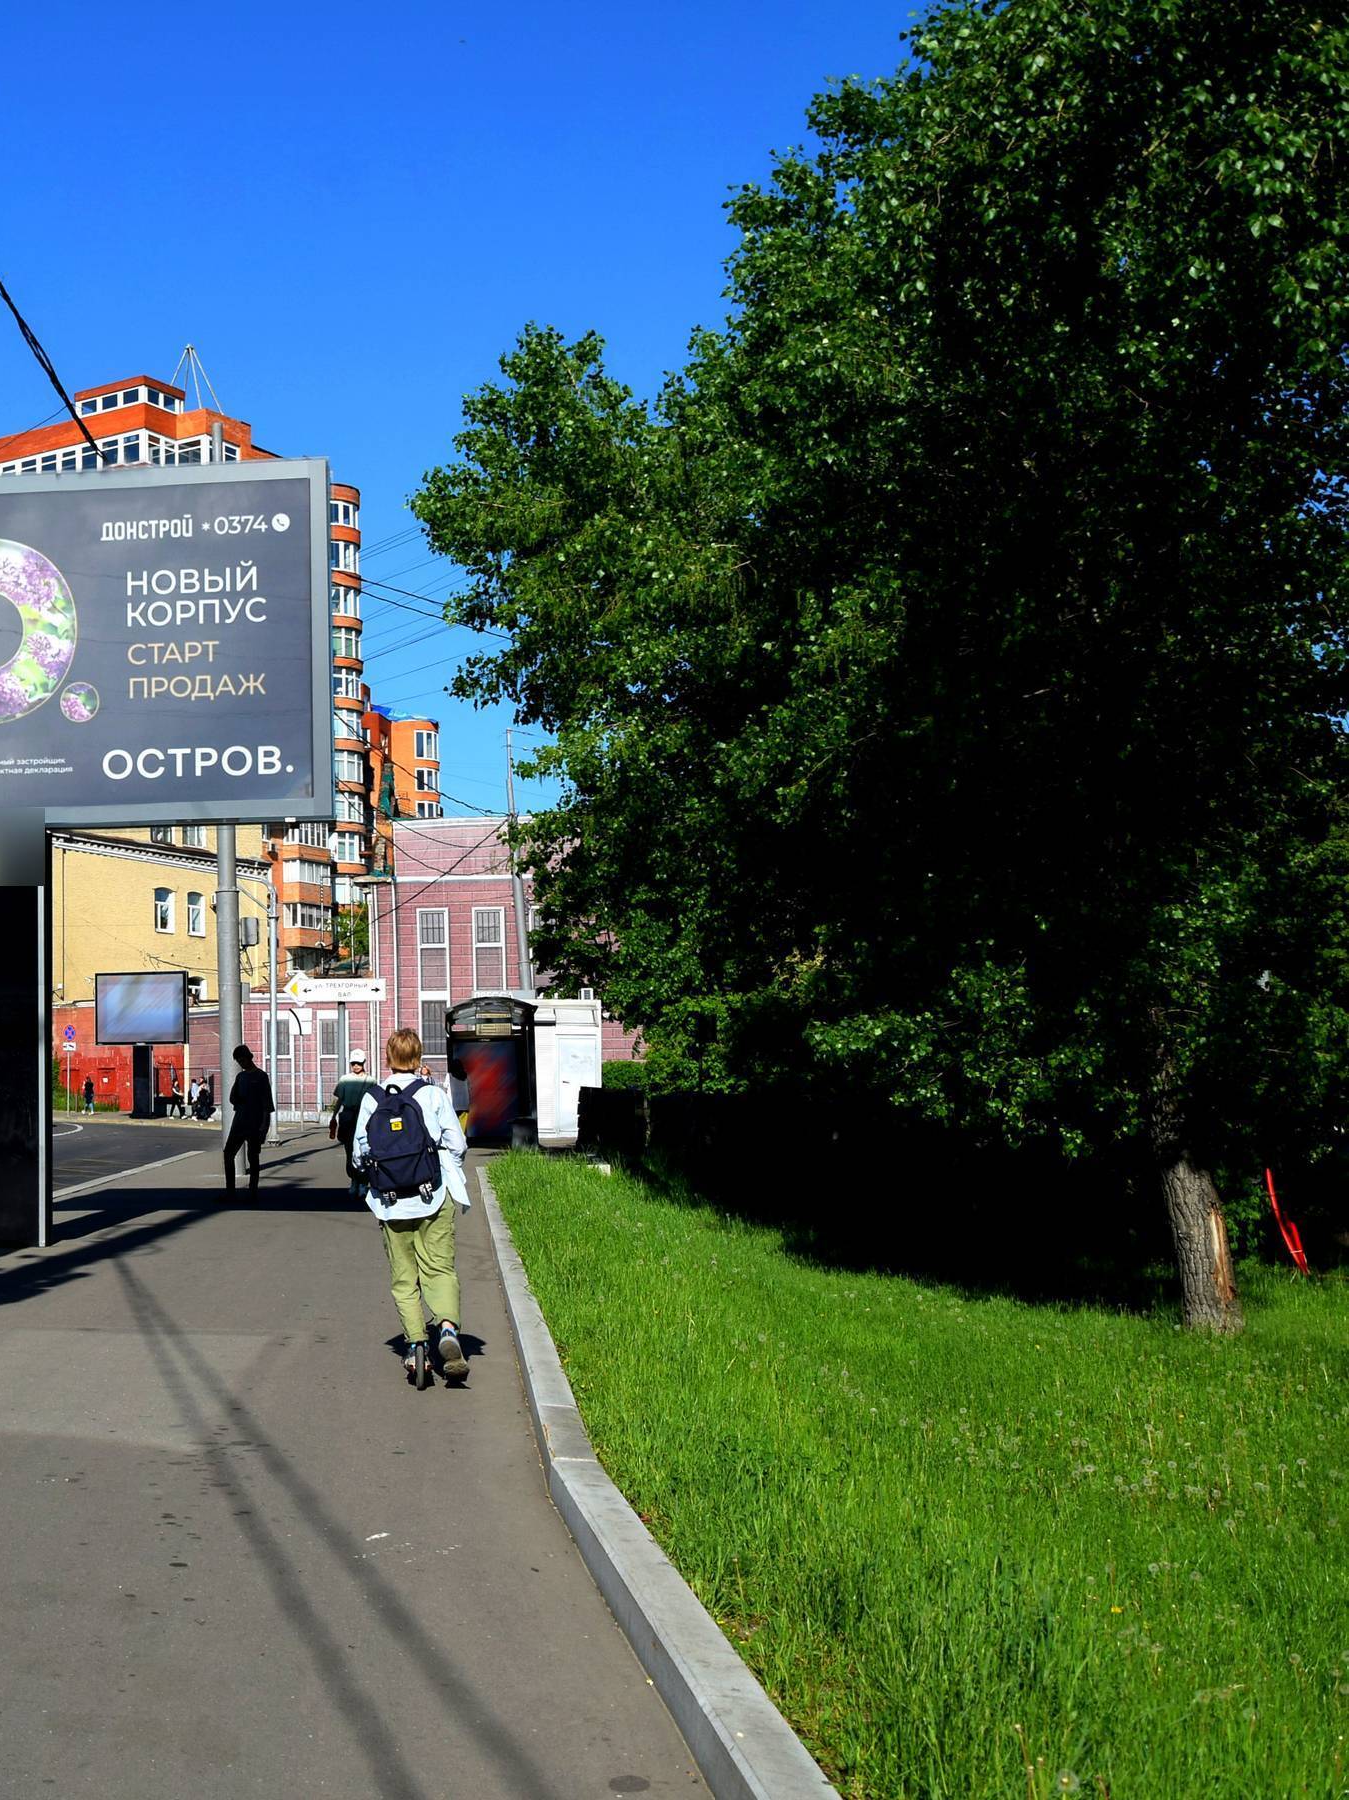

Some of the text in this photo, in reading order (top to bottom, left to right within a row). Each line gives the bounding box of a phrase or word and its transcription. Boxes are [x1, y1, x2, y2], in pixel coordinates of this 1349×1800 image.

[100, 514, 193, 541] ДОНСТРОЙ
[126, 560, 259, 595] НОВЫЙ
[126, 597, 267, 627] КОРПУС
[127, 640, 220, 665] СТАРТ
[128, 673, 266, 700] ПРОДАЖ
[16, 757, 66, 766] застройщик
[24, 765, 74, 774] декларация
[101, 745, 295, 780] ОСТРОВ.
